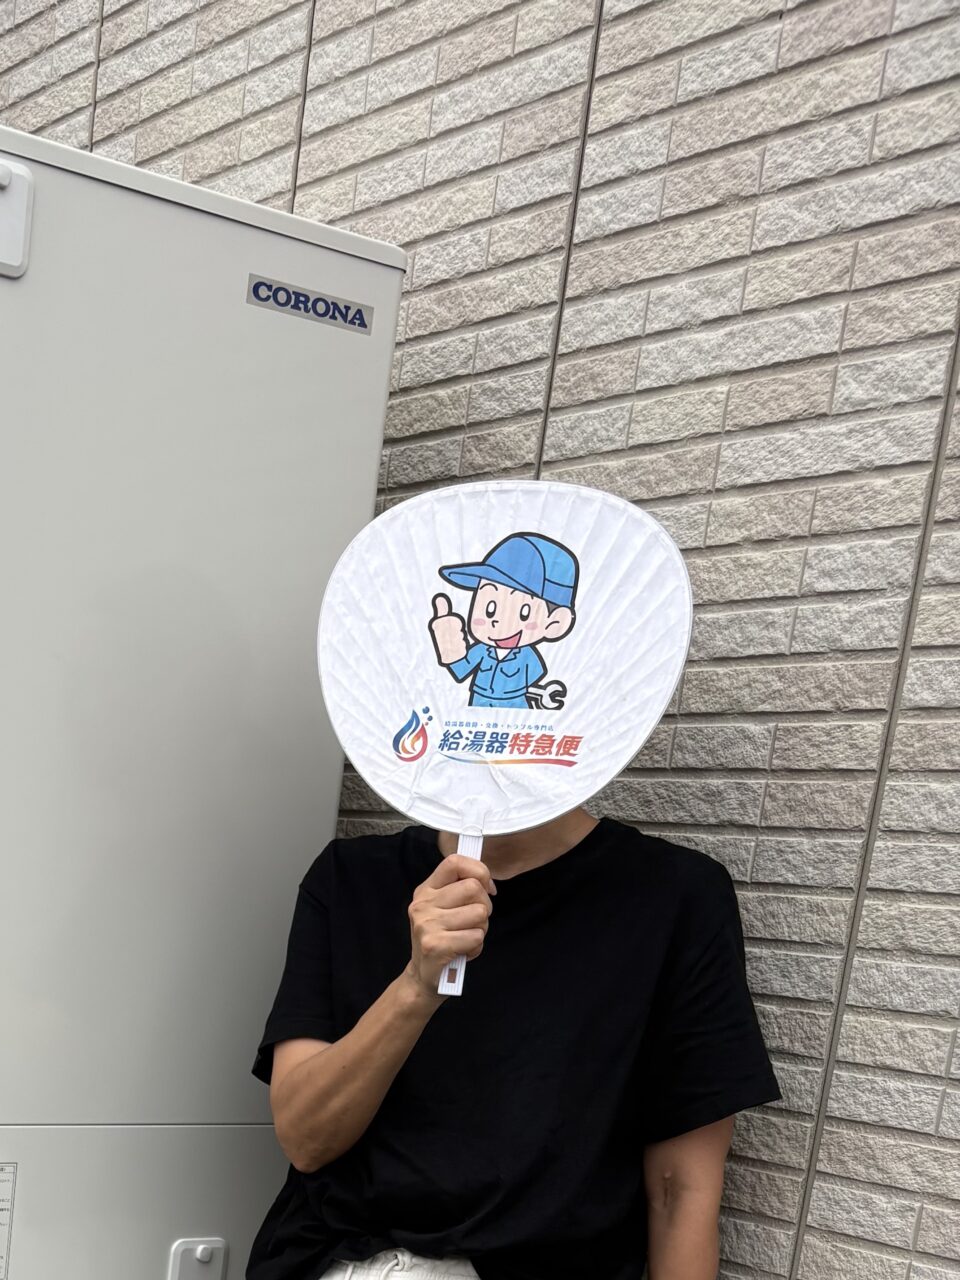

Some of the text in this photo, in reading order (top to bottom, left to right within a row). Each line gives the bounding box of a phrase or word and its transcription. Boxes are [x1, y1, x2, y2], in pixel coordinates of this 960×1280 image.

[252, 281, 368, 329] CORONA
[438, 729, 584, 757] 給湯器特急便
